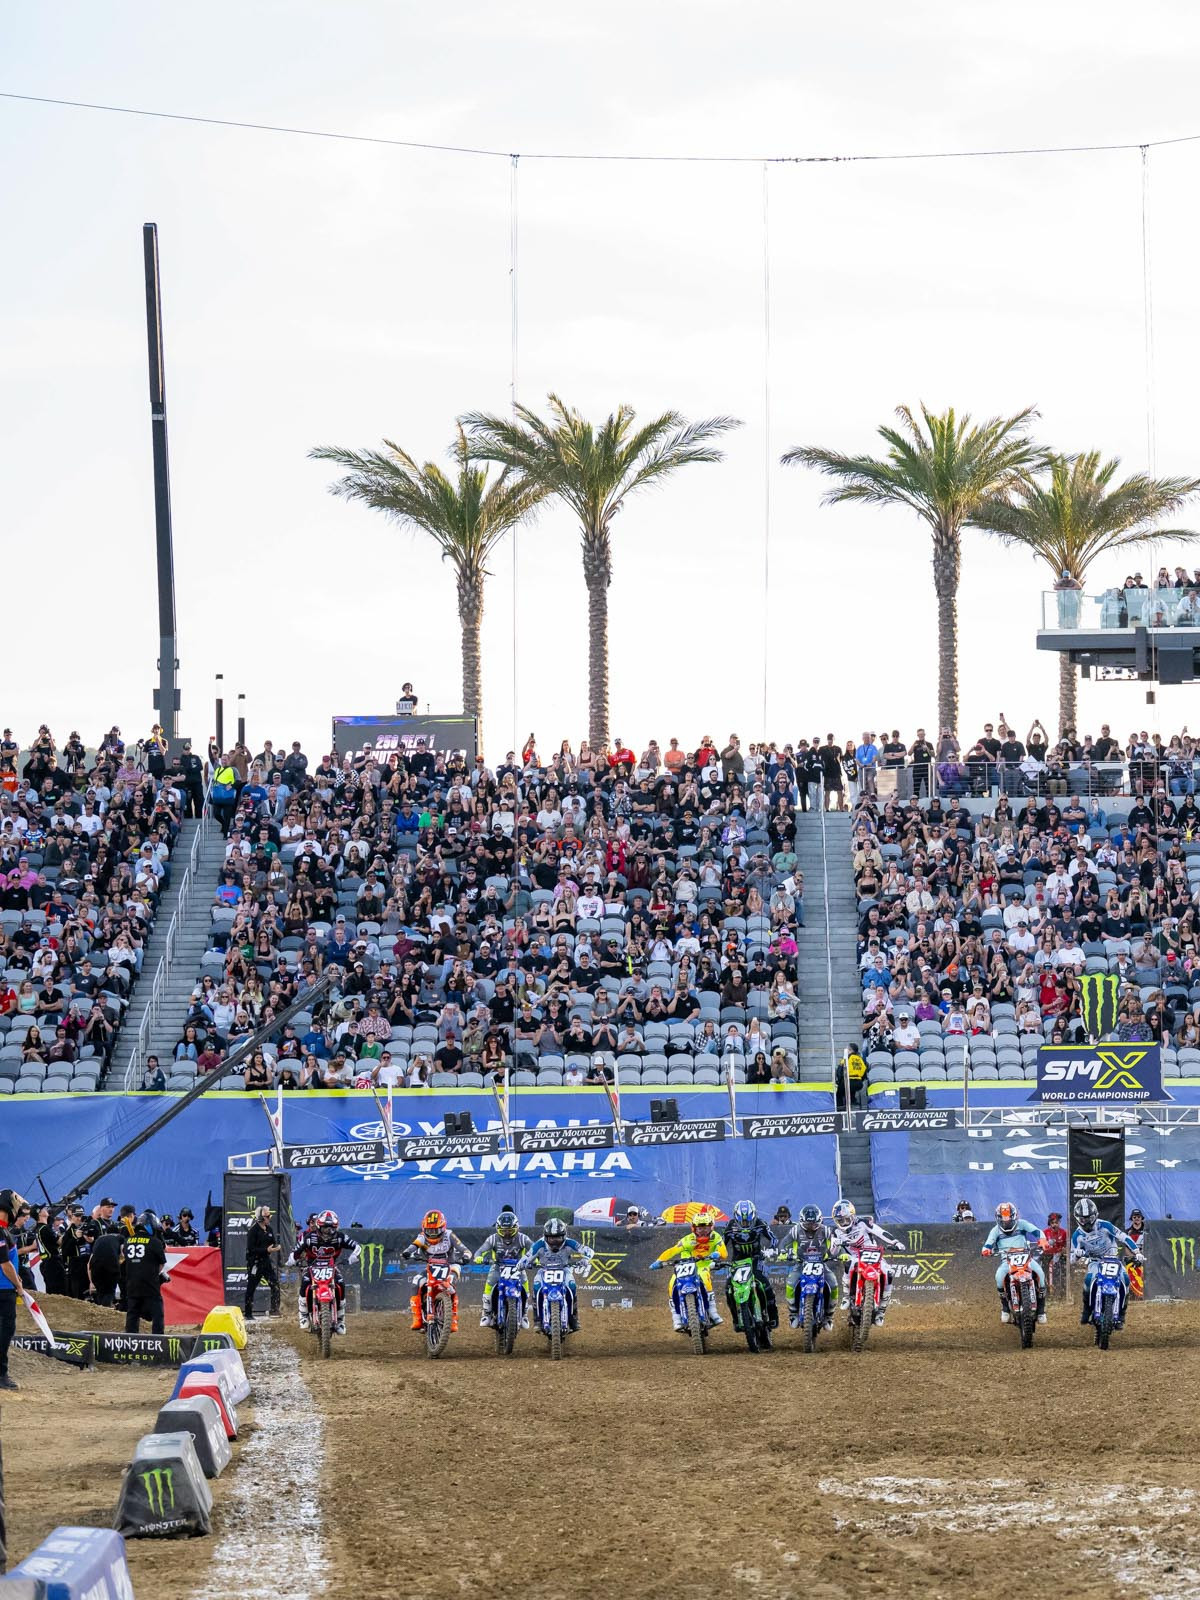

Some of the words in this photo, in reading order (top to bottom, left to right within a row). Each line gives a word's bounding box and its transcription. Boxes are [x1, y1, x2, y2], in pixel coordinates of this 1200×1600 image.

[1041, 1051, 1148, 1089] SMX
[1042, 1092, 1076, 1100] WORLD
[1077, 1091, 1150, 1100] CHAMPIONSHIP
[763, 1118, 789, 1126] ROCKY
[791, 1116, 834, 1124] MOUNTAIN
[876, 1112, 902, 1120] ROCKY
[904, 1111, 948, 1119] MOUNTAIN
[534, 1130, 560, 1138] ROCKY
[562, 1128, 606, 1137] MOUNTAIN
[645, 1124, 671, 1132] ROCKY
[673, 1122, 716, 1131] MOUNTAIN
[418, 1138, 446, 1146] ROCKY
[447, 1136, 490, 1146] MOUNTAIN
[303, 1146, 331, 1155] ROCKY
[332, 1144, 375, 1154] MOUNTAIN
[411, 1152, 632, 1172] YAMAHA
[1073, 1176, 1118, 1194] SMX
[127, 1244, 146, 1258] 33
[861, 1251, 880, 1263] 29
[1009, 1254, 1028, 1265] 137
[313, 1268, 332, 1280] 245
[432, 1266, 448, 1278] 71
[500, 1267, 520, 1280] 42
[676, 1263, 696, 1277] 237
[733, 1266, 751, 1282] 47
[802, 1262, 823, 1276] 43
[1101, 1262, 1119, 1276] 19
[544, 1270, 564, 1283] 60
[104, 1336, 163, 1352] MONSTER
[140, 1518, 188, 1534] MONSTER
